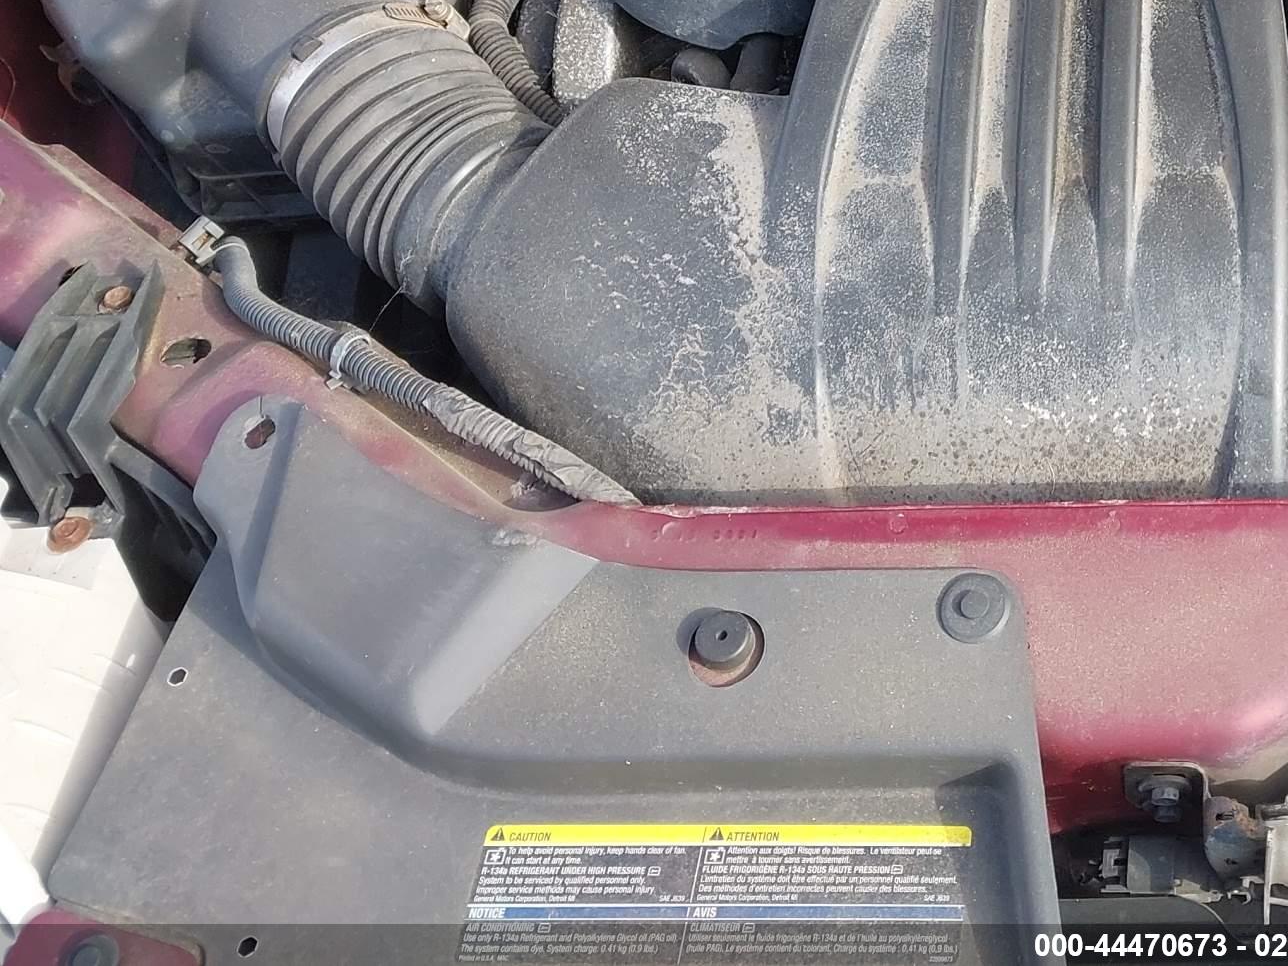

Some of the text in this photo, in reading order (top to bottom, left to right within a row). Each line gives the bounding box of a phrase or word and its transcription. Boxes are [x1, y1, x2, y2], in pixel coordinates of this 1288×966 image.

[509, 832, 552, 842] CAUTION
[726, 832, 780, 842] ATTENTION
[518, 847, 533, 856] help
[554, 847, 584, 856] personal
[606, 847, 624, 856] keep
[798, 847, 820, 856] Risque
[916, 847, 932, 856] peut
[702, 866, 728, 874] FLUIDE
[779, 866, 805, 874] R-134a
[807, 866, 827, 874] SOUS
[828, 866, 852, 874] HAUTE
[854, 866, 890, 874] PRESSION
[479, 876, 504, 885] System
[554, 876, 562, 885] by
[564, 876, 594, 885] qualified
[630, 876, 646, 885] only.
[859, 876, 893, 884] personnel
[476, 886, 506, 894] Improper
[565, 886, 579, 894] may
[603, 886, 634, 894] personal
[468, 908, 506, 918] NOTICE
[693, 907, 717, 917] AVIS
[466, 923, 535, 932] AIR CONDITIONING
[690, 923, 740, 932] CLIMATISEUR
[478, 934, 491, 943] only
[520, 934, 557, 943] Refrigerant
[617, 934, 637, 943] Glycol
[461, 944, 473, 952] The
[474, 945, 498, 953] system
[500, 944, 529, 952] contains
[546, 944, 572, 953] System
[618, 944, 627, 953] kg
[726, 944, 734, 952] Le
[765, 944, 792, 952] contient
